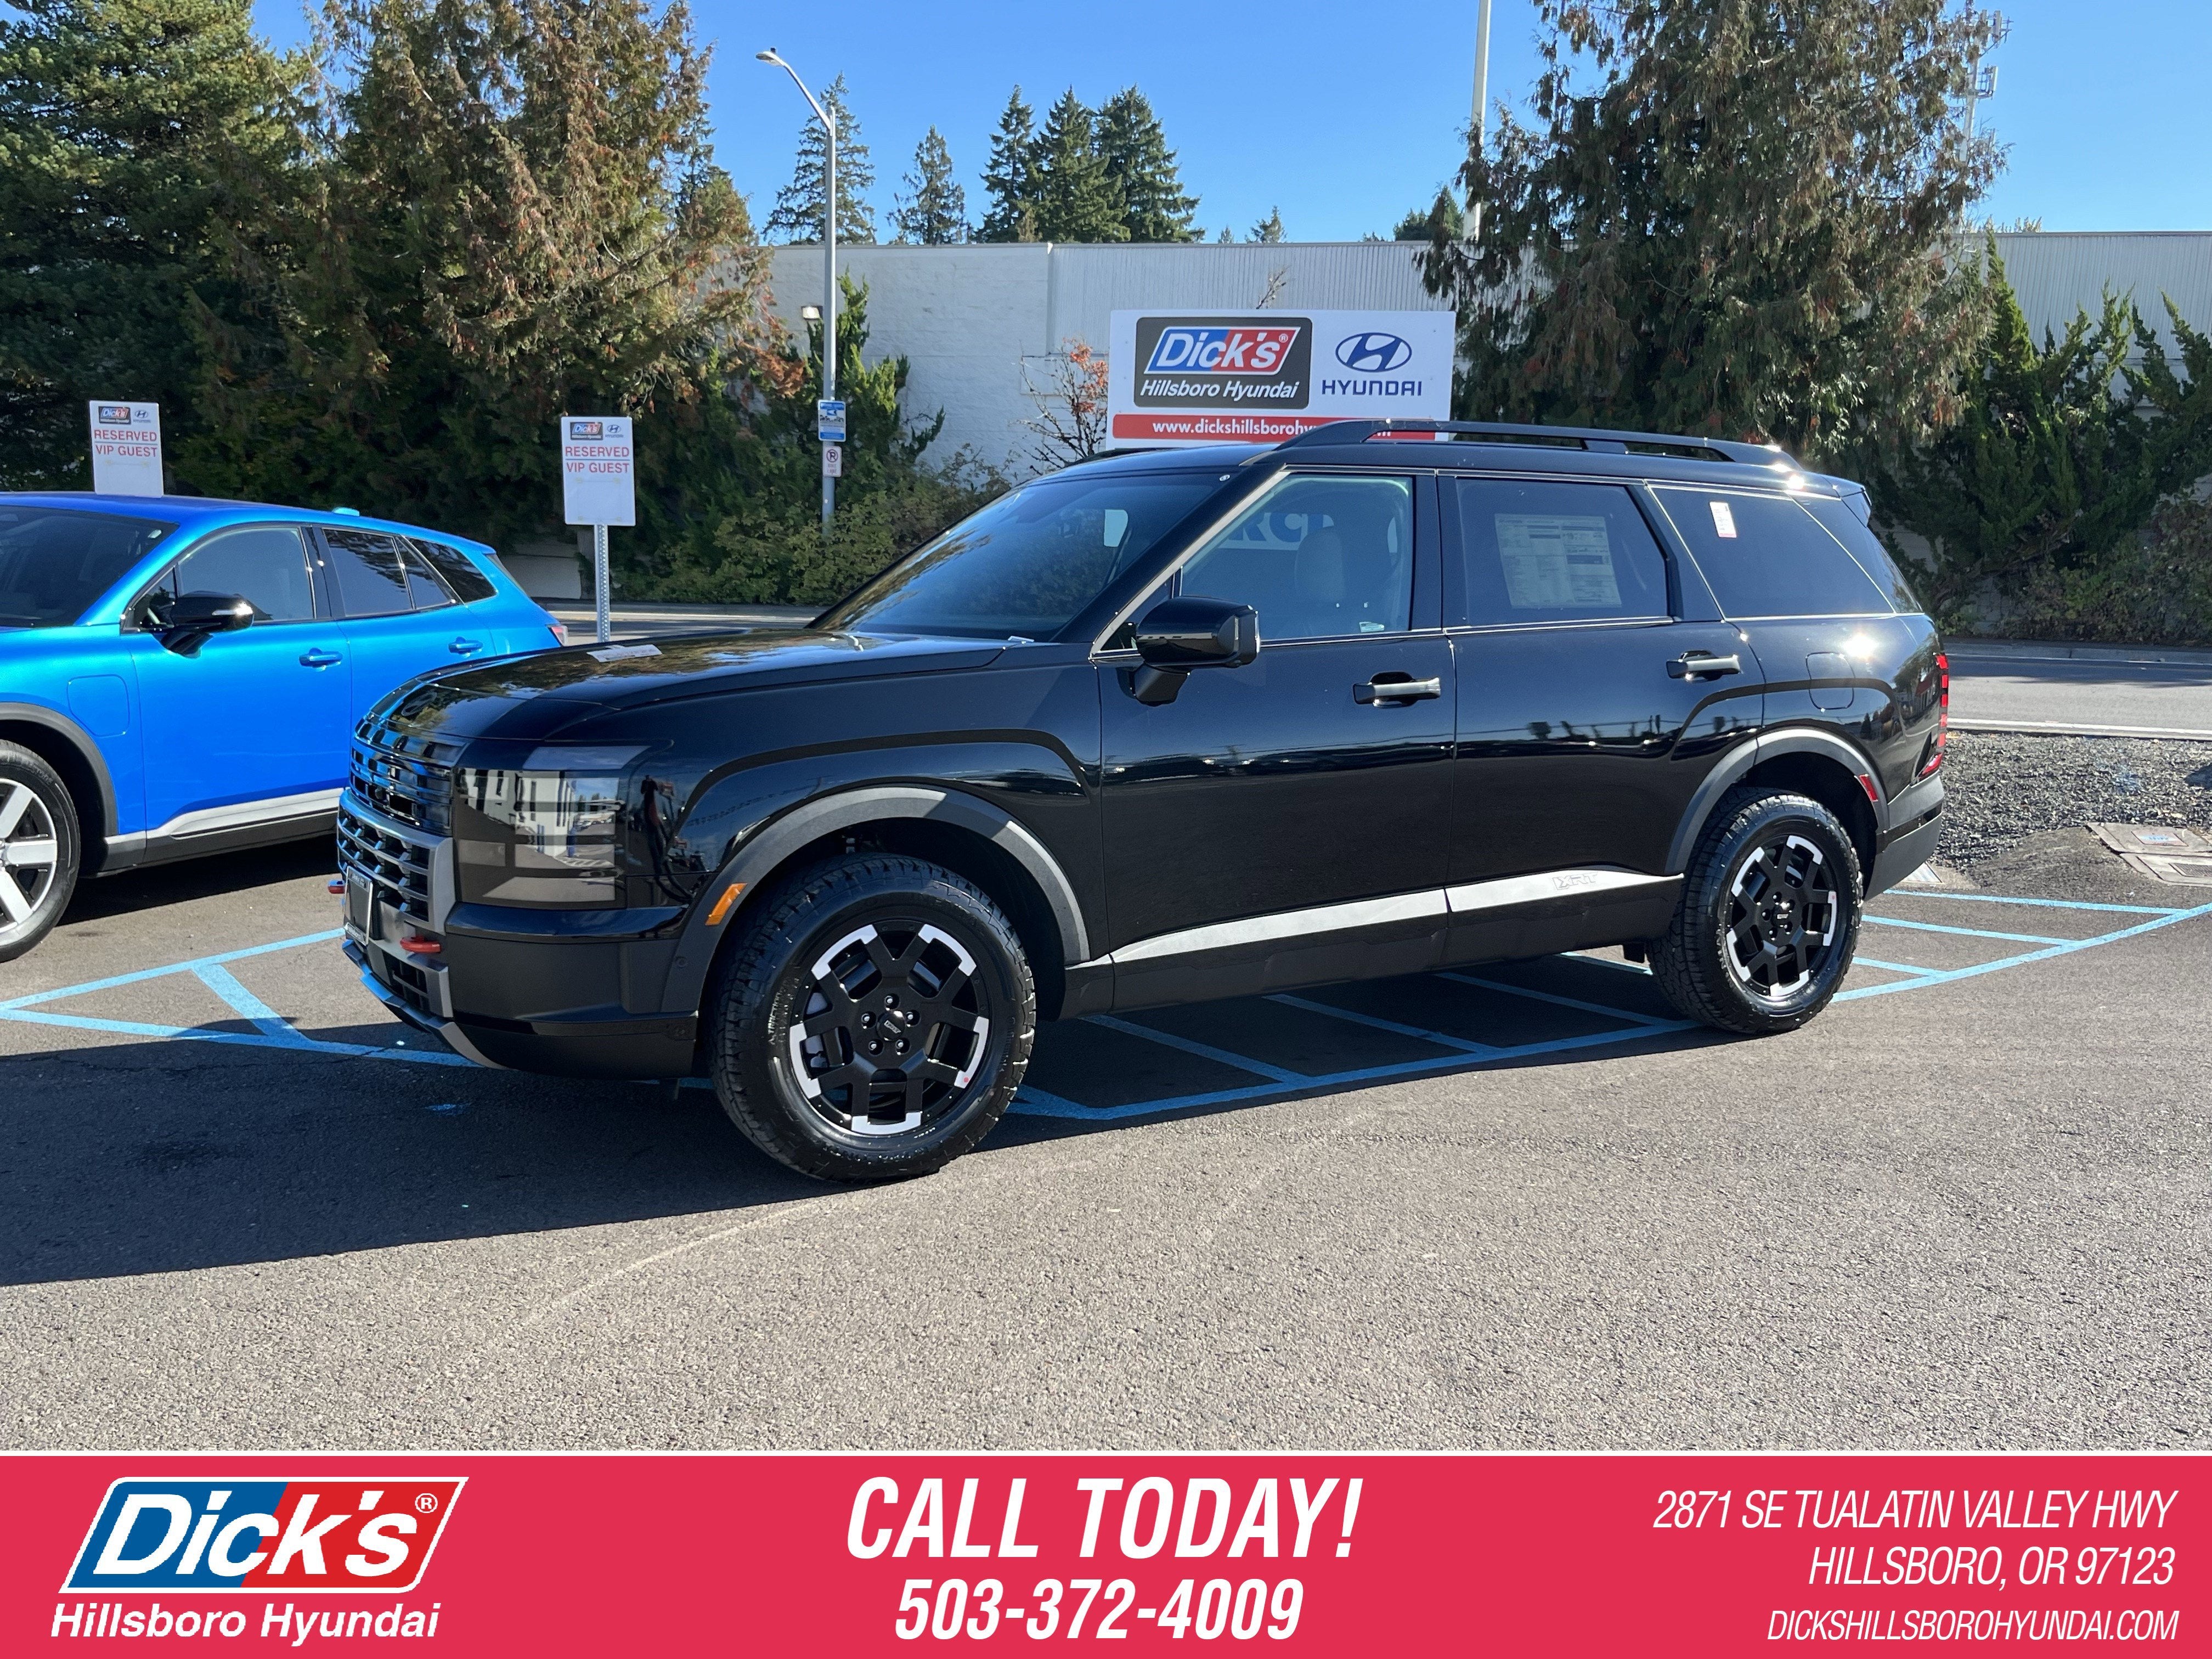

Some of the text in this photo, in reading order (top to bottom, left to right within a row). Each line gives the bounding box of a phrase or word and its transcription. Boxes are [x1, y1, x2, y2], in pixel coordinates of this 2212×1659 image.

[1156, 332, 1280, 369] Dick's
[1140, 380, 1300, 402] Hillsboro Hyundai
[1322, 380, 1422, 396] HYUNDAI
[94, 430, 157, 442] RESERVED
[95, 444, 157, 458] VIP GUEST
[565, 446, 630, 457] RESERVED
[566, 462, 630, 473] VIP GUEST
